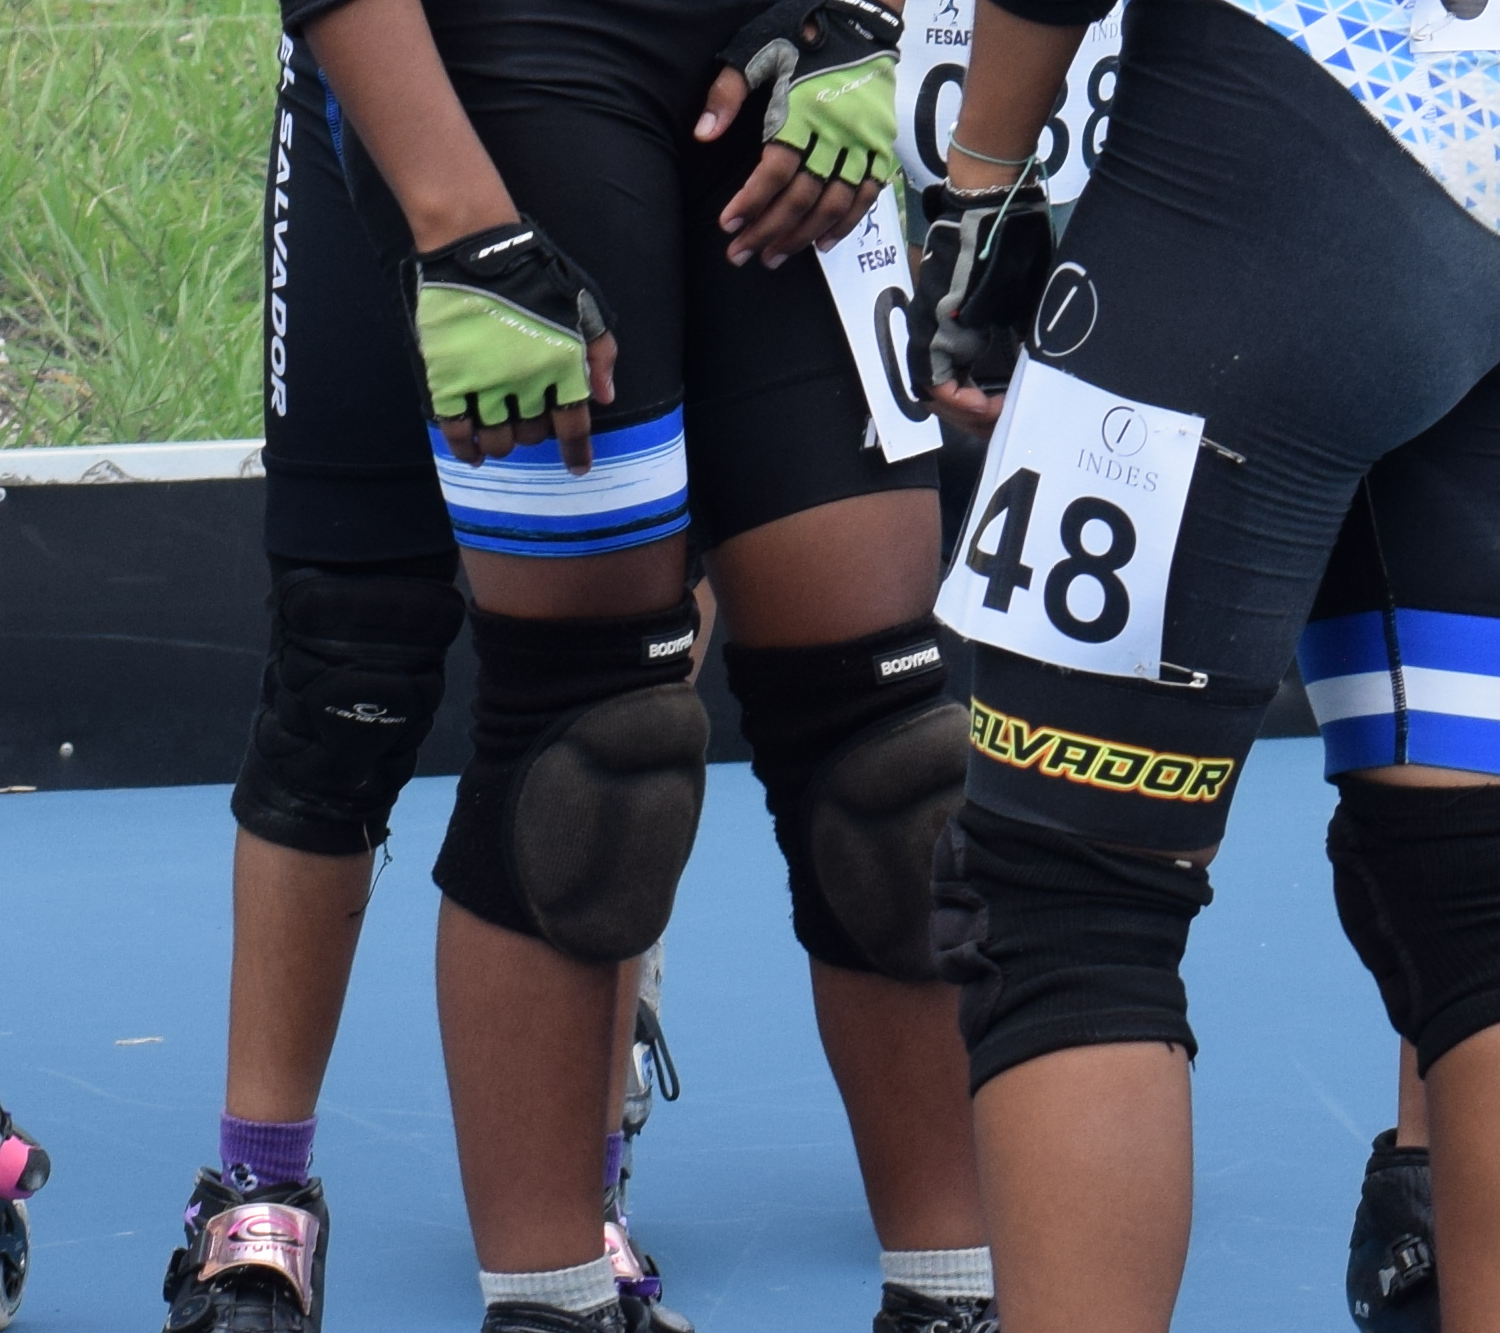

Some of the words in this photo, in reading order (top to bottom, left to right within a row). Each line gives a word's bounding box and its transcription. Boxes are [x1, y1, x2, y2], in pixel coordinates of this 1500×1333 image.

[278, 32, 296, 92] EL
[270, 107, 293, 418] SALVADOR
[857, 247, 898, 274] FESAP
[1077, 448, 1160, 493] INDES
[964, 466, 1138, 645] 48
